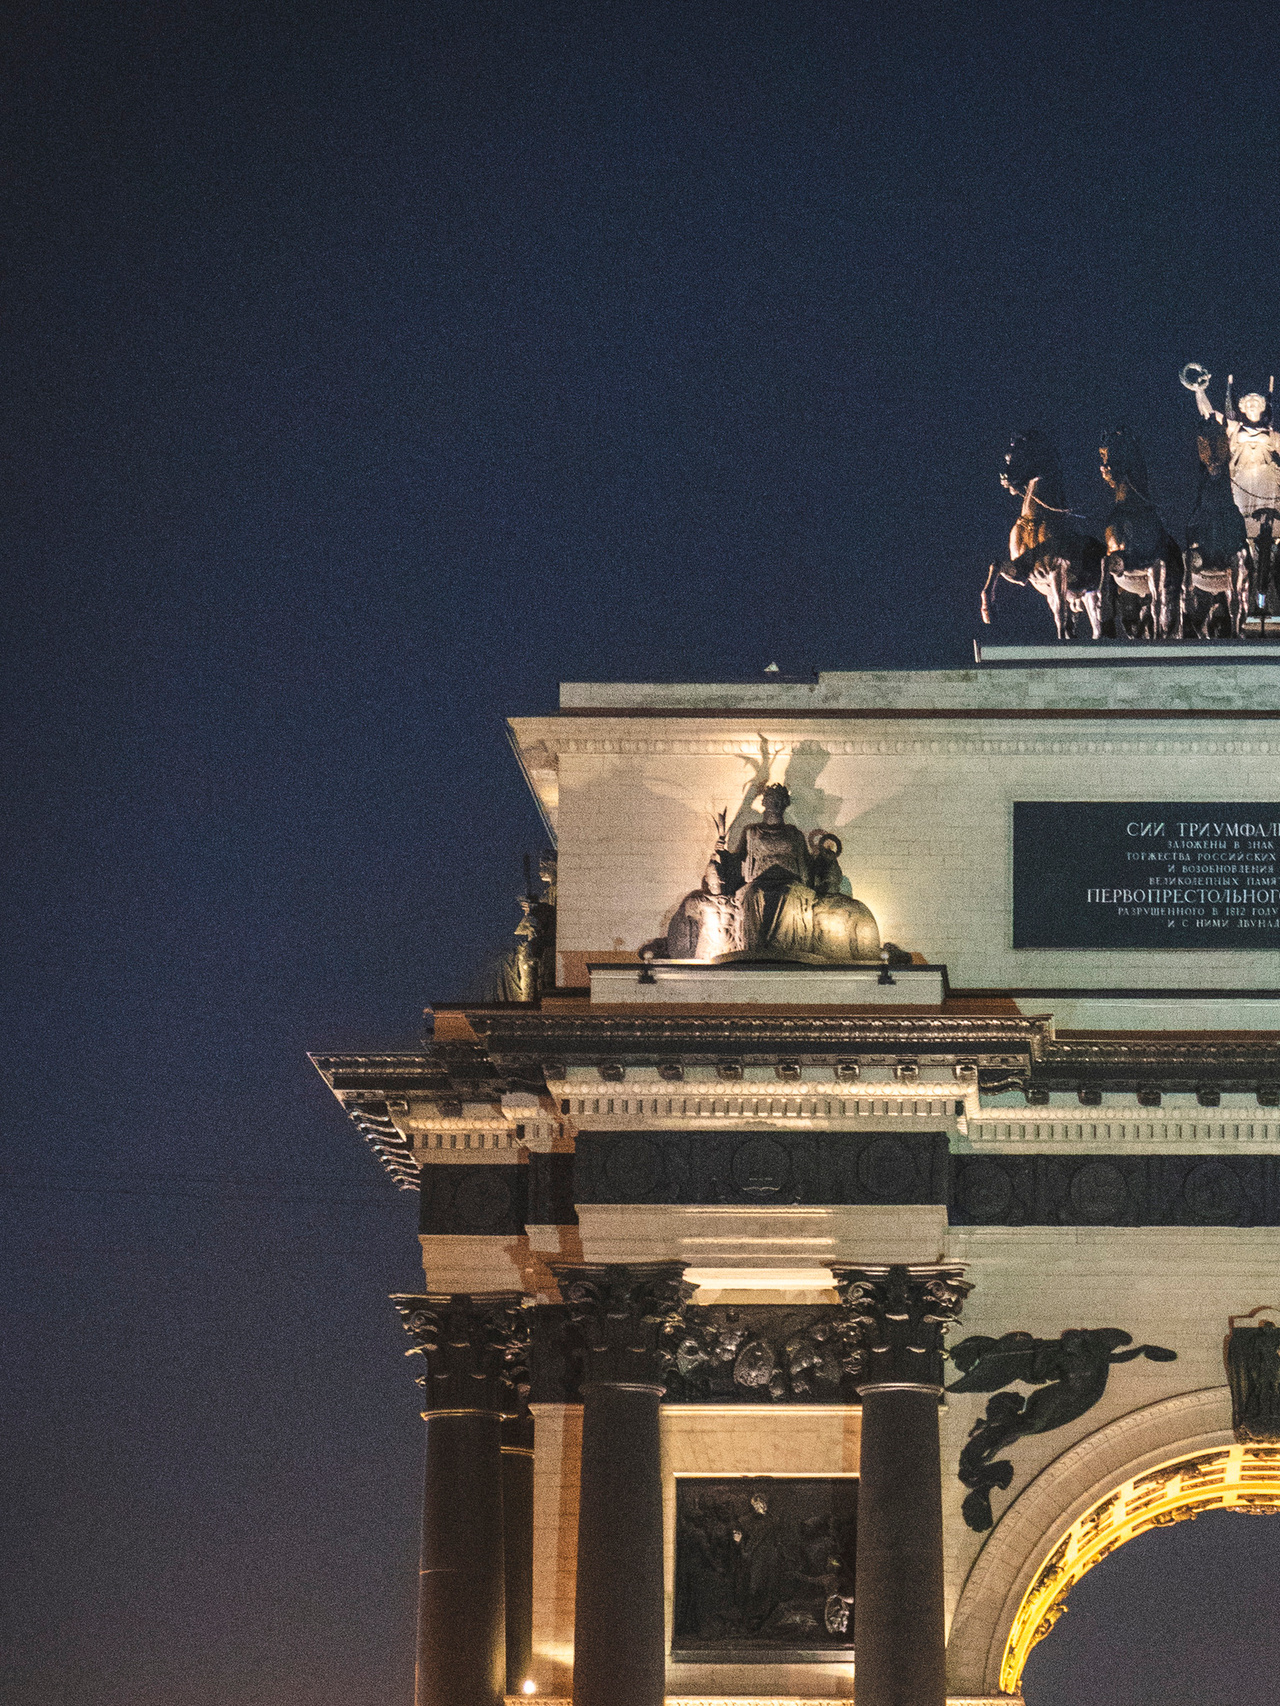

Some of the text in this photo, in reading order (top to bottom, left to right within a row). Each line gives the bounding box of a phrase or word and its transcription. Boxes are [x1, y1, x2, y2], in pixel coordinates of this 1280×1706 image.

[1127, 822, 1165, 836] СИИ
[1168, 841, 1227, 850] ЗАЛОЖЕНЫ
[1234, 841, 1240, 850] В
[1248, 841, 1274, 850] ЗНАК
[1198, 851, 1276, 861] РОССИЙСКИХ
[1168, 864, 1176, 874] И
[1182, 864, 1274, 874] ВОЗОБНОВЛЕНИЯ
[1150, 877, 1240, 886] ВЕЛИКОЛЕПНЫХ
[1118, 907, 1205, 916] РАЗРУШЕННОГО
[1212, 907, 1218, 916] В
[1226, 907, 1246, 916] 1812
[1168, 919, 1175, 928] И
[1182, 919, 1189, 928] С
[1196, 919, 1228, 928] НИМИ
